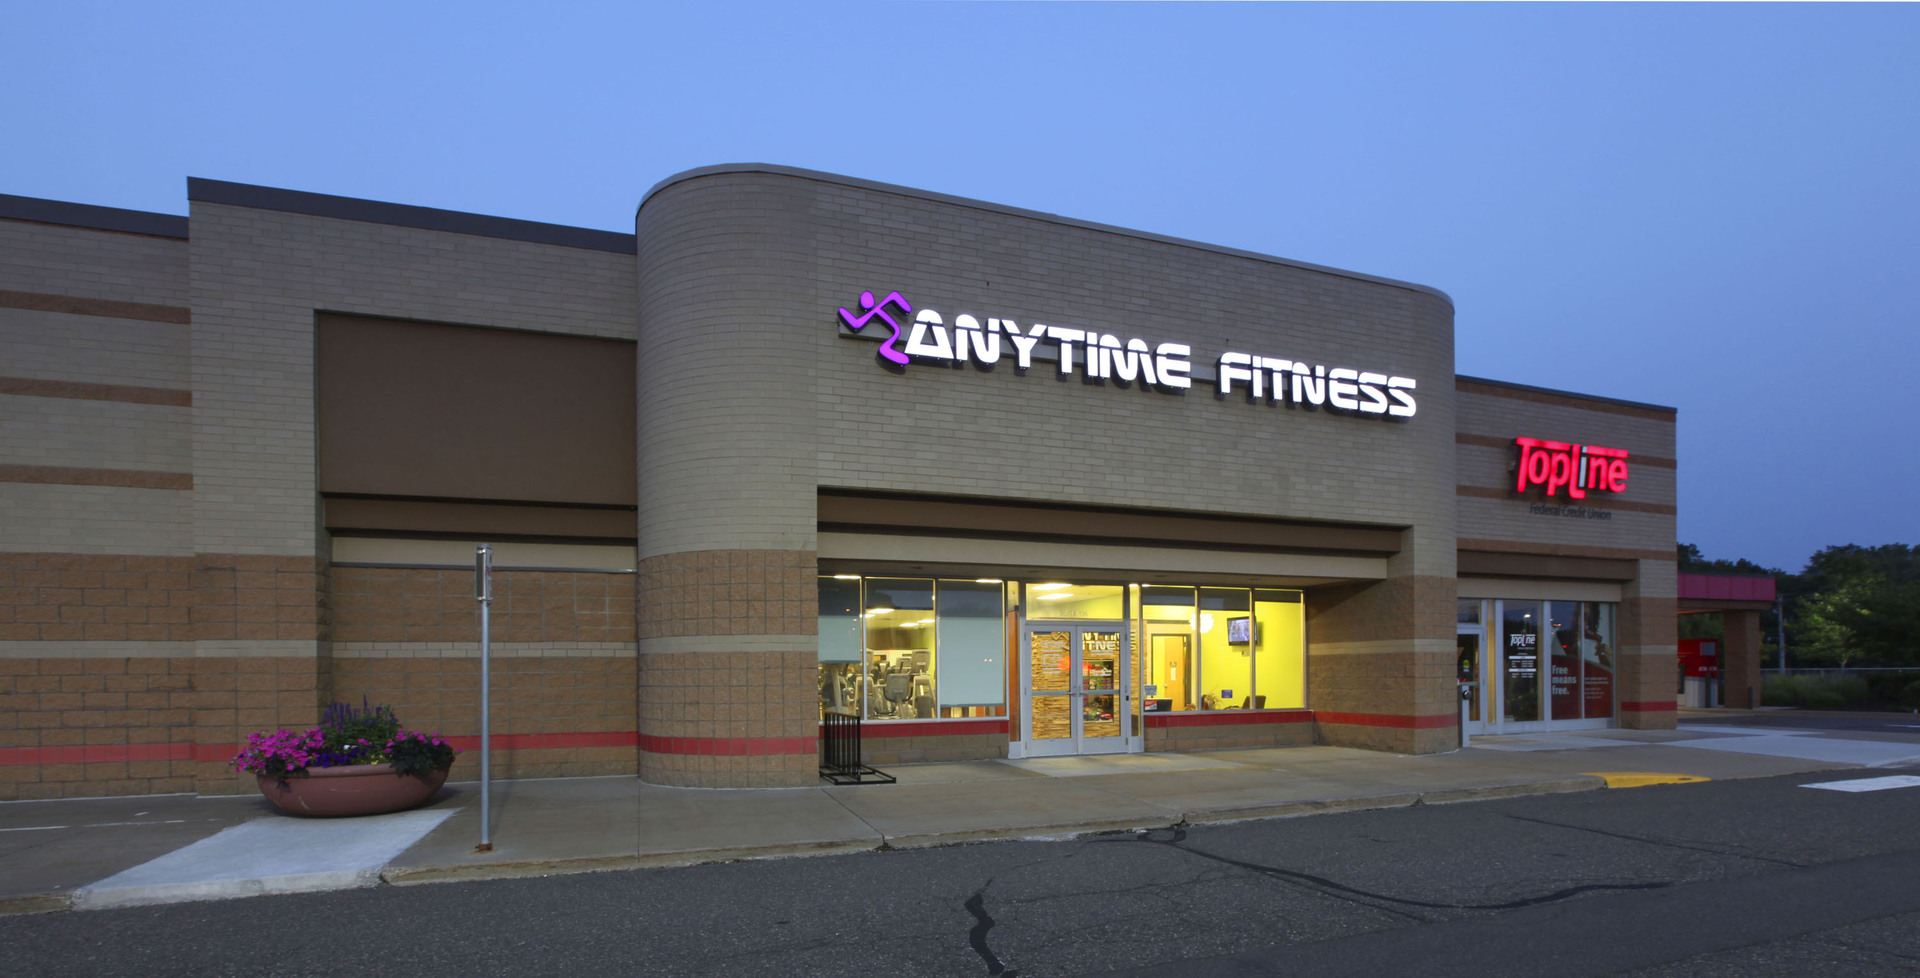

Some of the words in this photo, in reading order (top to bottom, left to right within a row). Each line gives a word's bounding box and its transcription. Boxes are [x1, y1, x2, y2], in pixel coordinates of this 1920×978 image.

[904, 308, 1191, 389] ANYTIME
[1220, 352, 1417, 418] FITNESS
[1529, 502, 1560, 516] Federal
[1562, 504, 1586, 518] Credit
[1587, 507, 1612, 520] Union
[1552, 676, 1577, 684] means
[1552, 684, 1570, 695] free.
